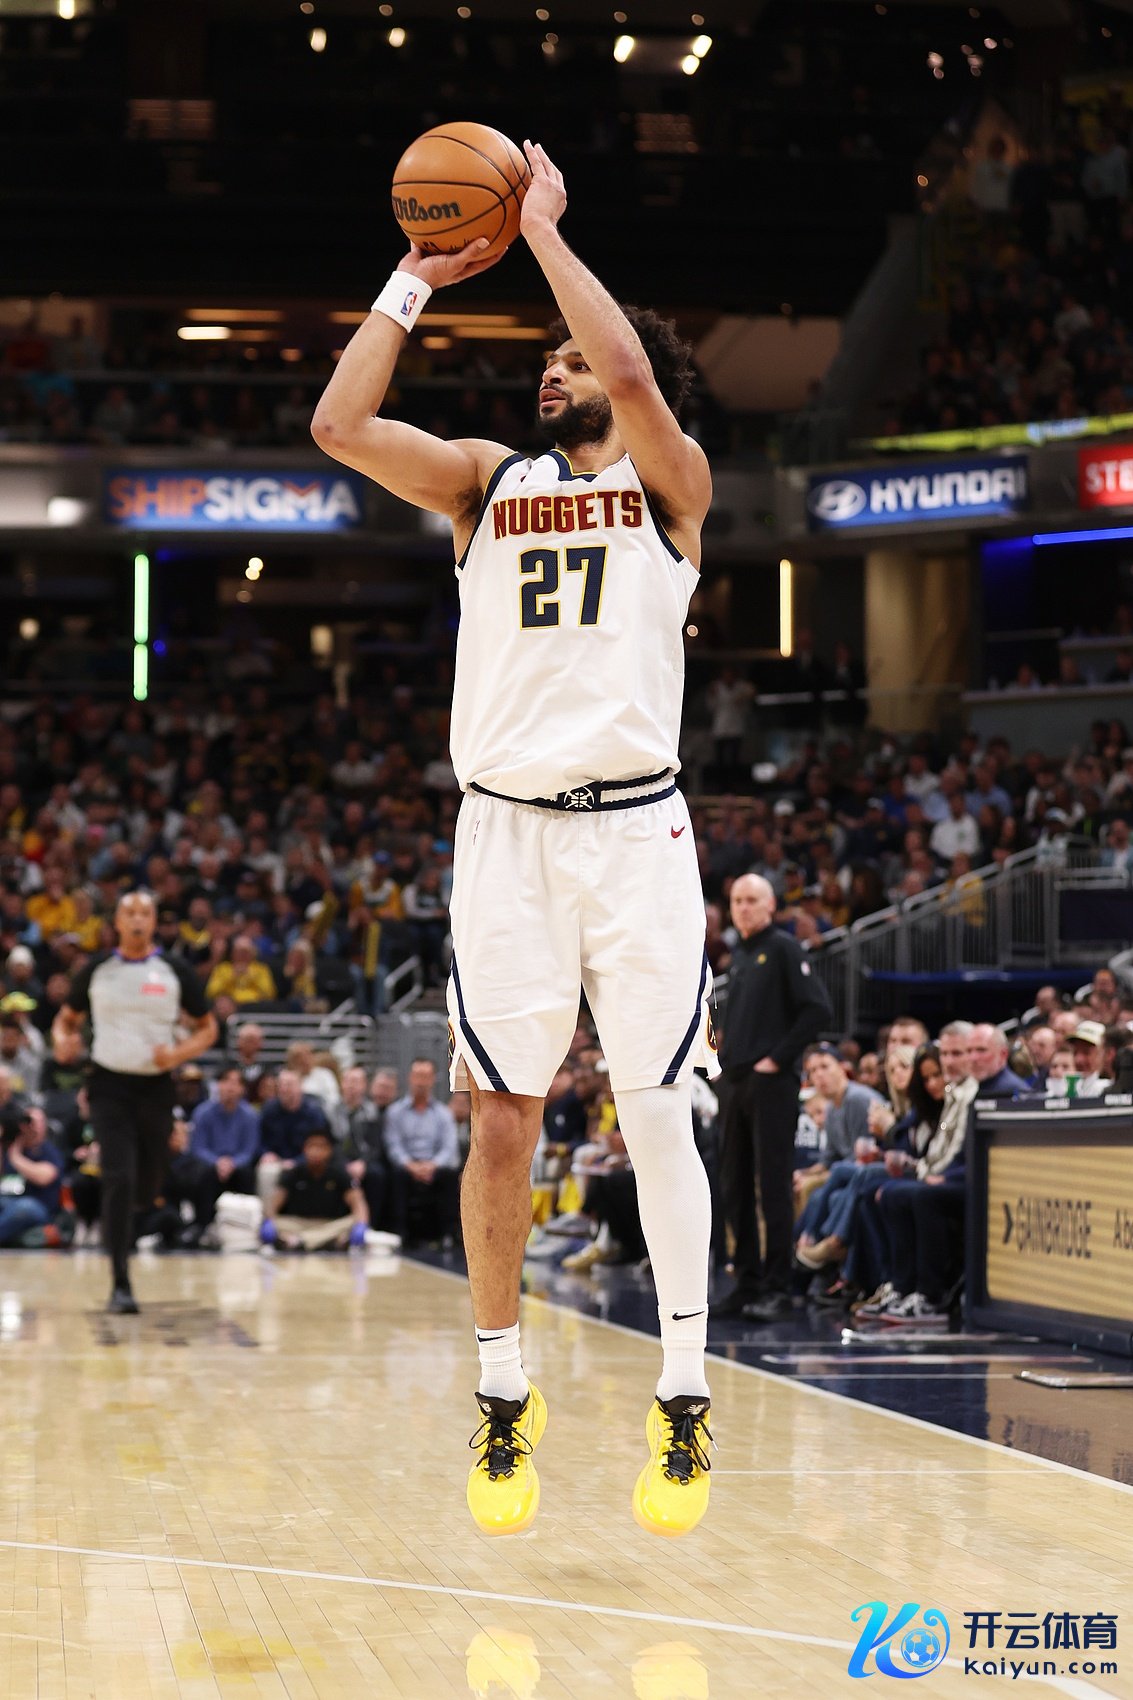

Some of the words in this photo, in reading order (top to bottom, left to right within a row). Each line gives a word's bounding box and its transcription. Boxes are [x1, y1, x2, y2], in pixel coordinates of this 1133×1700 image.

[869, 466, 1026, 514] HYUNDAI
[492, 490, 643, 541] NUGGETS
[518, 544, 608, 630] 27
[1112, 1208, 1133, 1250] Ab
